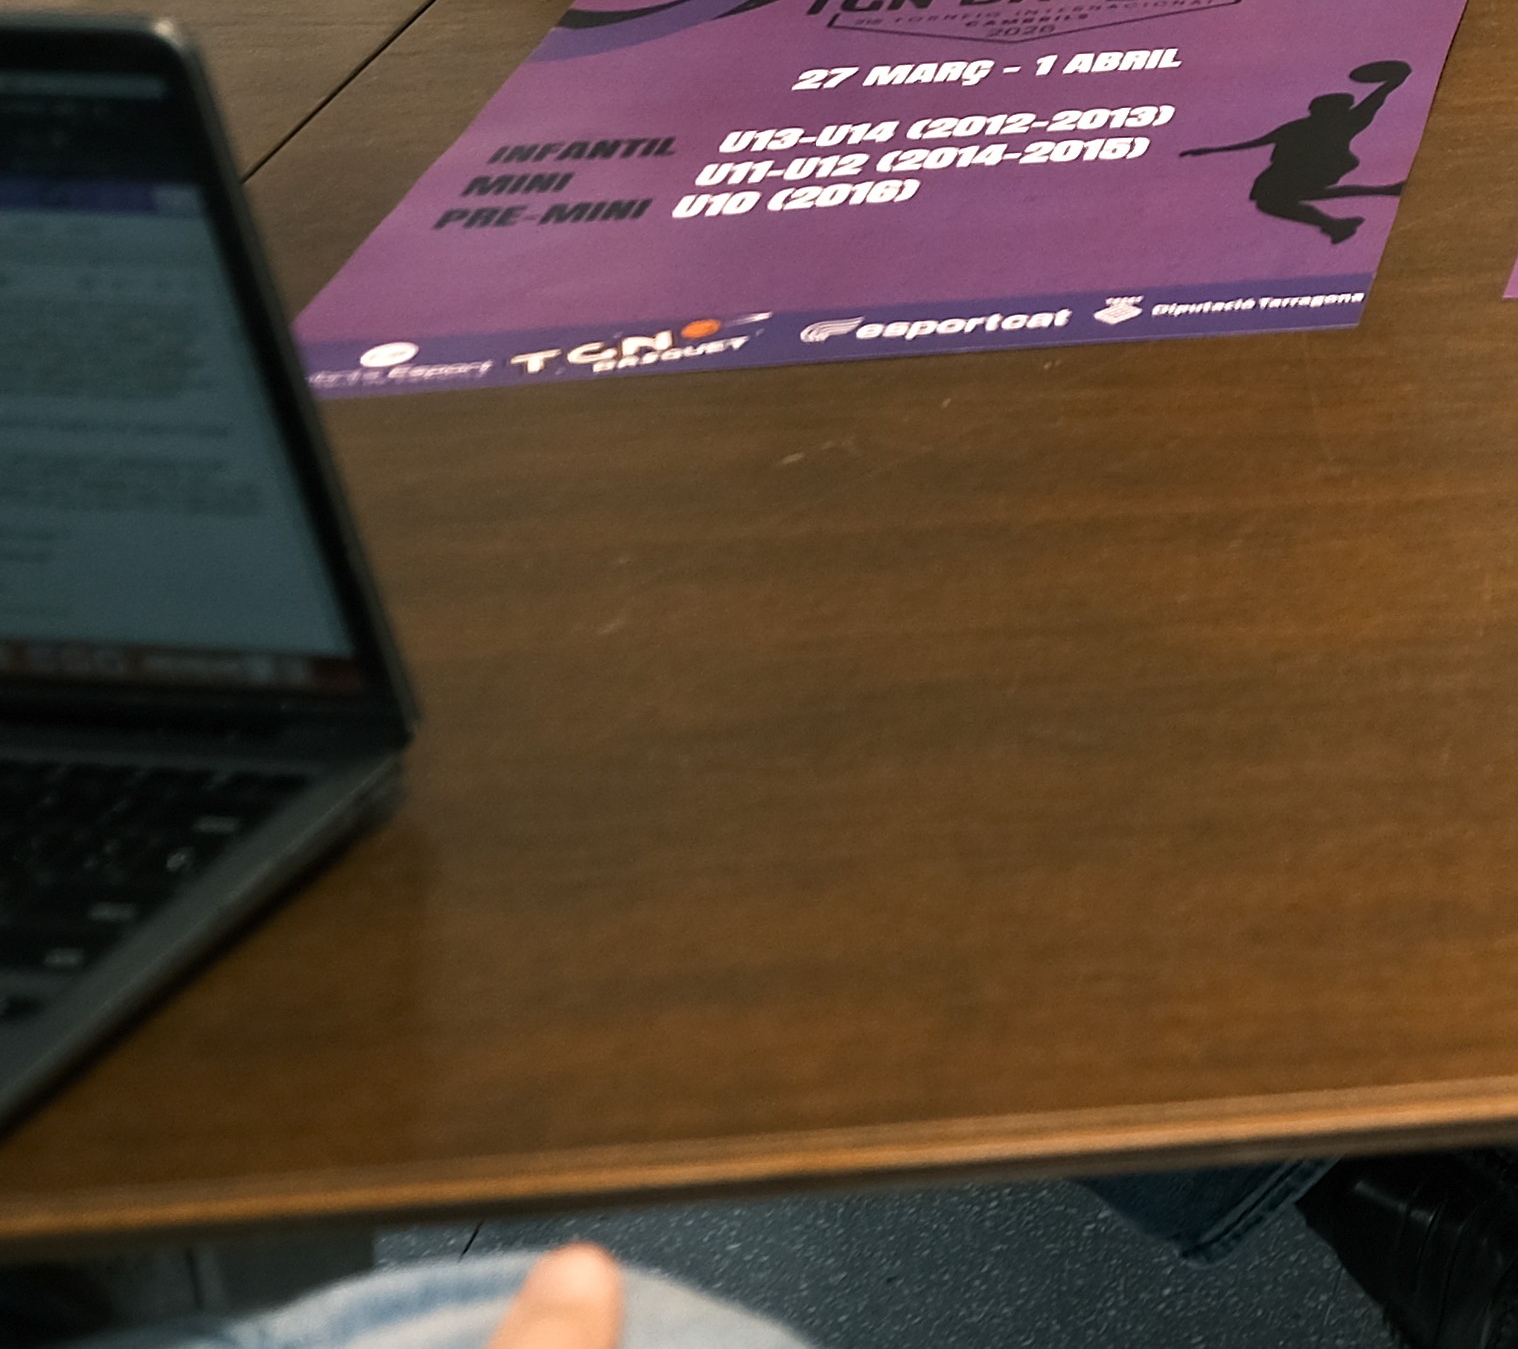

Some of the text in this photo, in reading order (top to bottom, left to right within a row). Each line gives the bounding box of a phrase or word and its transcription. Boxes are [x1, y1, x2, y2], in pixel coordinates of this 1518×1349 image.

[965, 11, 1089, 29] CAMBRILS
[986, 24, 1058, 41] 2026
[791, 66, 861, 92] 27
[861, 56, 993, 88] MARÇ
[1034, 54, 1061, 78] 1
[1061, 46, 1183, 76] ABRIL
[486, 102, 1178, 166] INFANTIL U13-U14 (2012-2013)
[461, 134, 1154, 201] MINI U11-U12 (2014-2015)
[431, 176, 922, 233] PRE-MINI U10 (2016)
[855, 306, 1072, 345] esportcat
[1152, 288, 1365, 320] Diputació Tarragona
[509, 327, 675, 376] TGN
